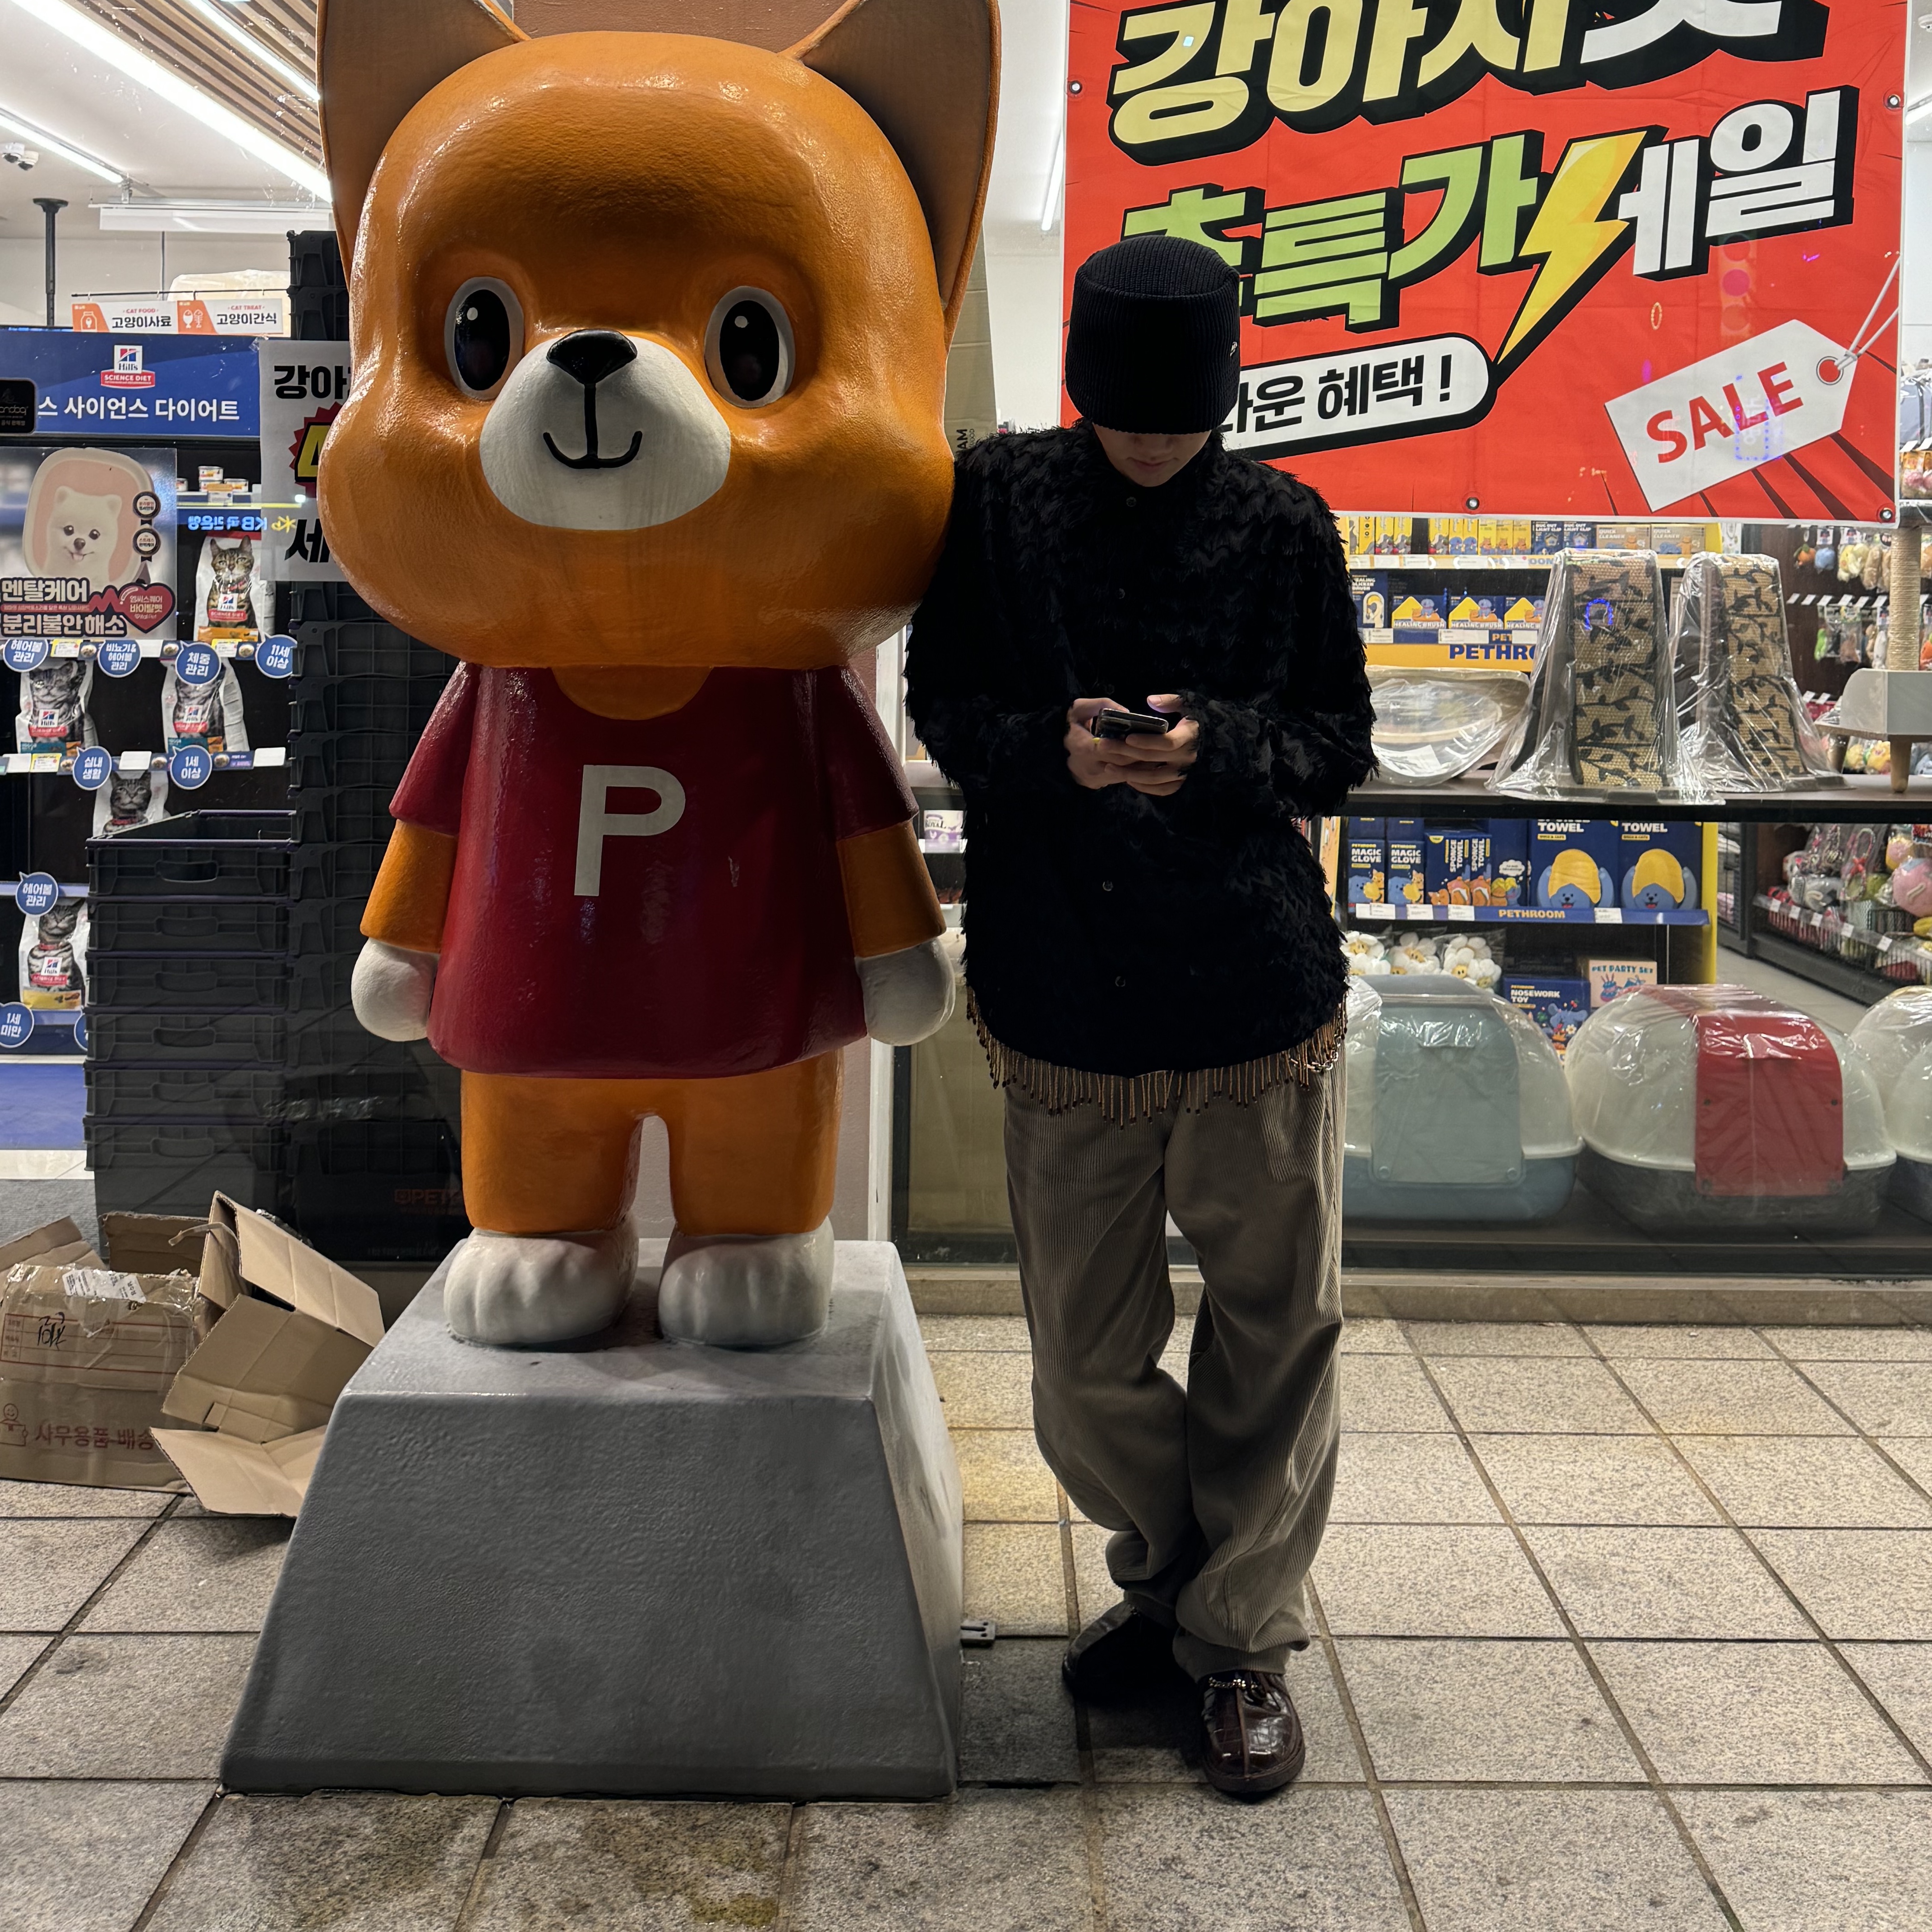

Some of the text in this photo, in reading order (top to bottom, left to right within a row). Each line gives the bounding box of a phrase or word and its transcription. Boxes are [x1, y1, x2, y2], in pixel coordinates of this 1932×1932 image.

[112, 316, 172, 328] 고양이사료
[217, 313, 277, 325] 고양이간식
[64, 396, 148, 419] 사이언스
[156, 398, 240, 422] 다이어트
[1646, 362, 1803, 463] SALE
[2, 580, 87, 602] 멘탈케어
[3, 614, 125, 635] 분리불안 해소
[11, 640, 43, 653] 헤어볼
[106, 643, 137, 652] 비뇨기&
[271, 644, 291, 658] 11세
[13, 652, 35, 663] 관리
[108, 653, 132, 661] 헤어볼
[187, 652, 211, 664] 체중
[266, 656, 289, 669] 이상
[111, 662, 127, 671] 관리
[185, 664, 208, 676] 관리
[84, 756, 103, 768] 실내
[185, 756, 199, 767] 1세
[83, 769, 101, 780] 생활
[181, 768, 201, 779] 이상
[574, 764, 686, 897] P
[1538, 822, 1584, 832] TOWEL
[1622, 823, 1668, 832] TOWEL
[23, 883, 53, 896] 헤어볼
[26, 895, 46, 907] 관리
[1499, 909, 1565, 919] PETHROOM
[1511, 989, 1560, 998] NOSEWORK
[6, 1013, 21, 1025] 1세
[0, 1025, 22, 1038] 미만
[35, 1424, 154, 1450] 사무용품 배송
